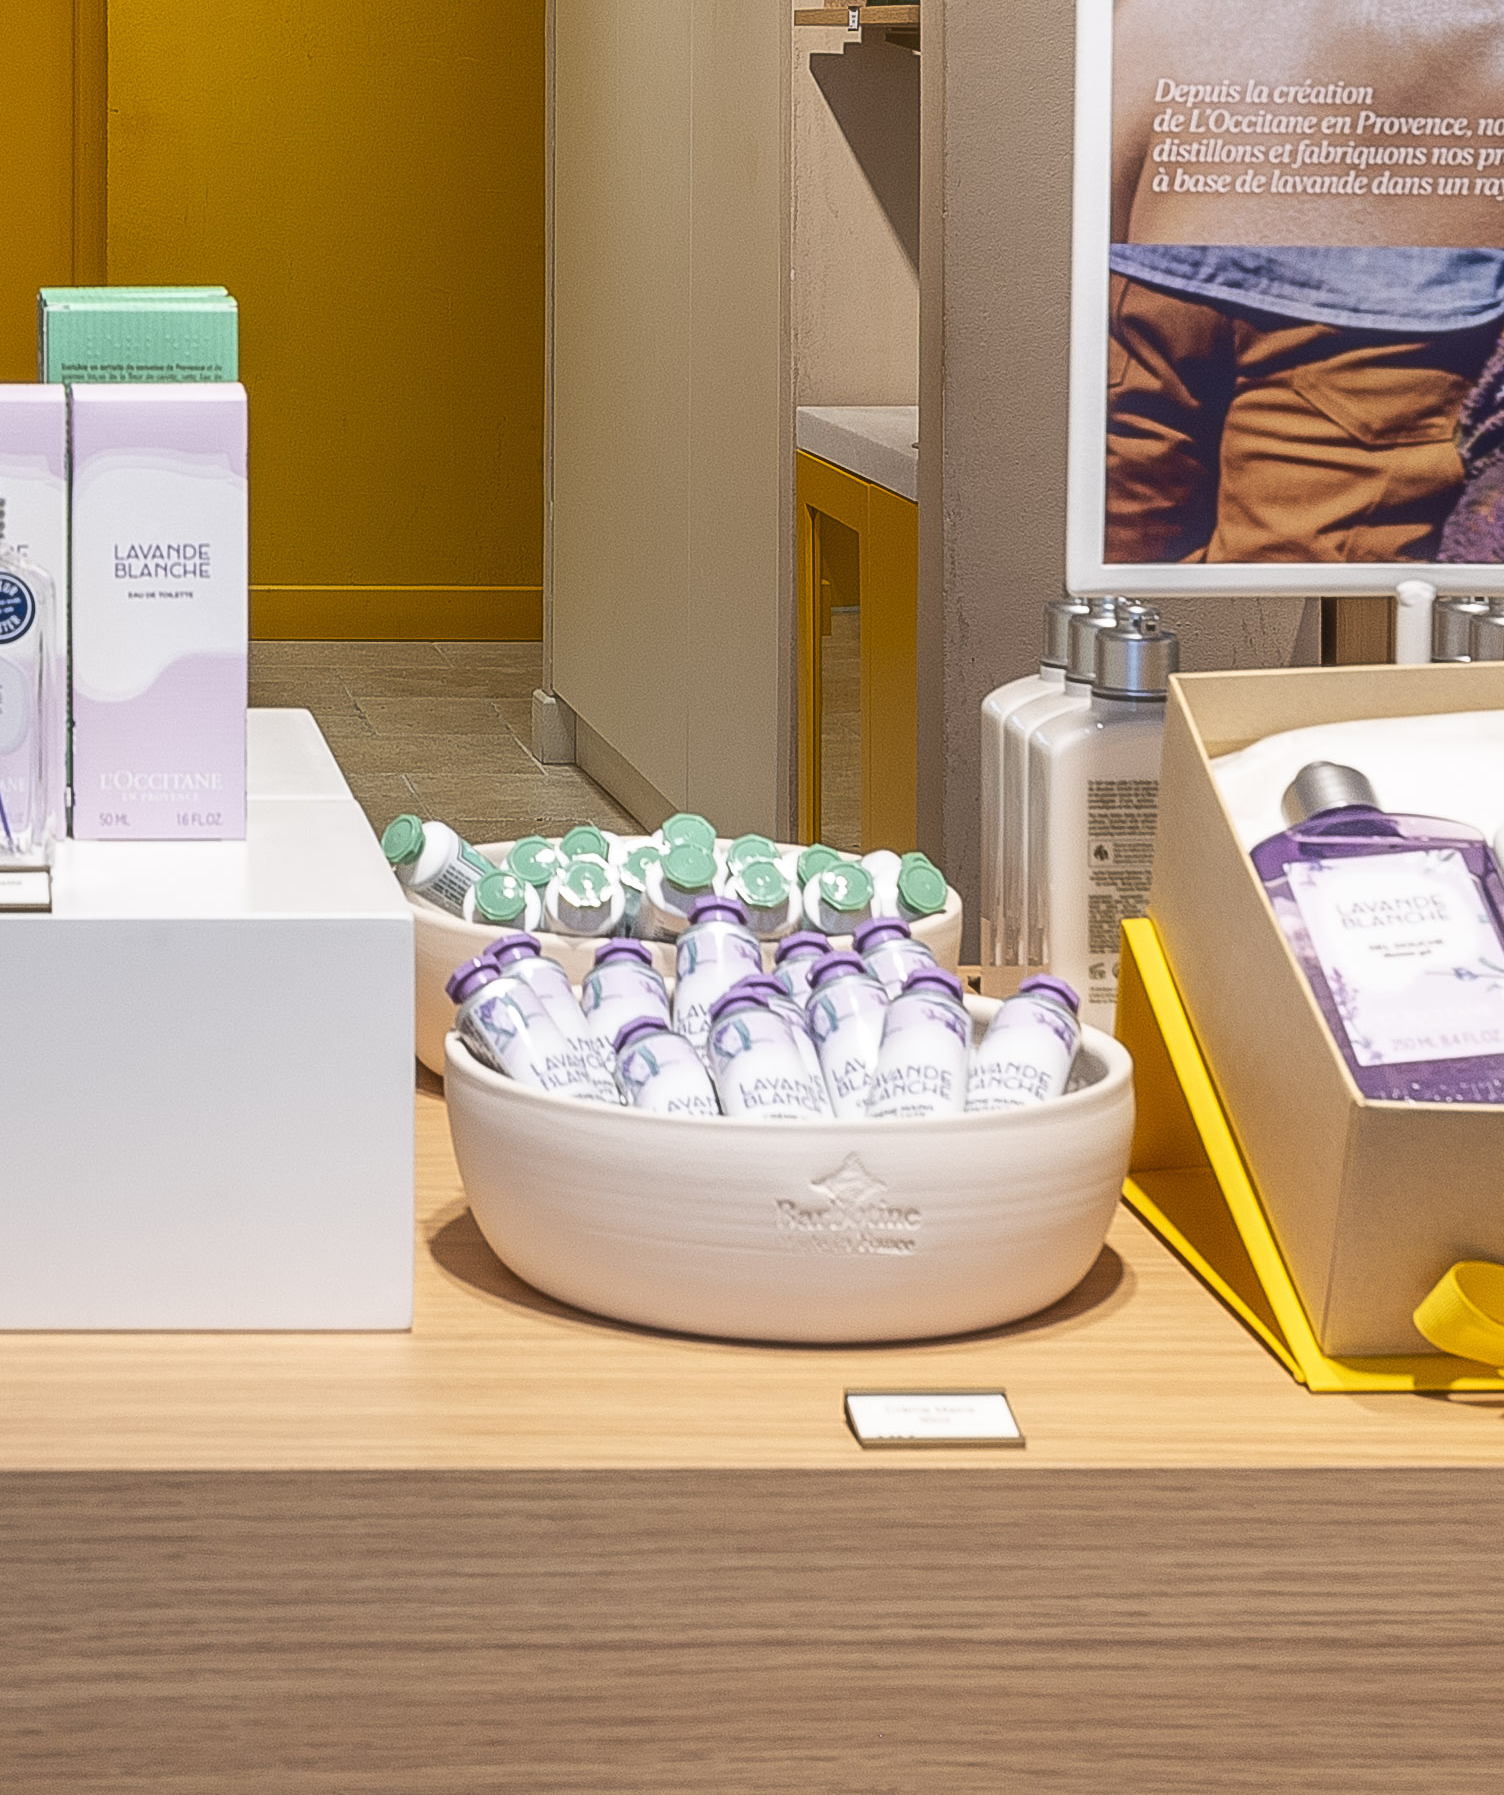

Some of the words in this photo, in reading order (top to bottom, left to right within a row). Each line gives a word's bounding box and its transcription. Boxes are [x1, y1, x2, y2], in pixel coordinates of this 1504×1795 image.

[1155, 78, 1241, 107] Depuis
[1245, 79, 1269, 104] la
[1273, 79, 1373, 104] création
[1153, 108, 1184, 133] de
[1189, 109, 1317, 134] L'Occitane
[1321, 116, 1351, 134] en
[1356, 110, 1472, 137] Provence,
[1152, 138, 1265, 163] distillons
[1268, 143, 1292, 164] et
[1291, 140, 1426, 169] fabriquons
[1431, 146, 1474, 165] nos
[1152, 166, 1169, 192] à
[1174, 168, 1231, 193] base
[1235, 169, 1266, 193] de
[1270, 169, 1367, 194] lavande
[1372, 171, 1433, 194] dans
[1437, 178, 1469, 195] un
[114, 543, 211, 561] LAVANDE
[114, 562, 211, 579] BLANCHE
